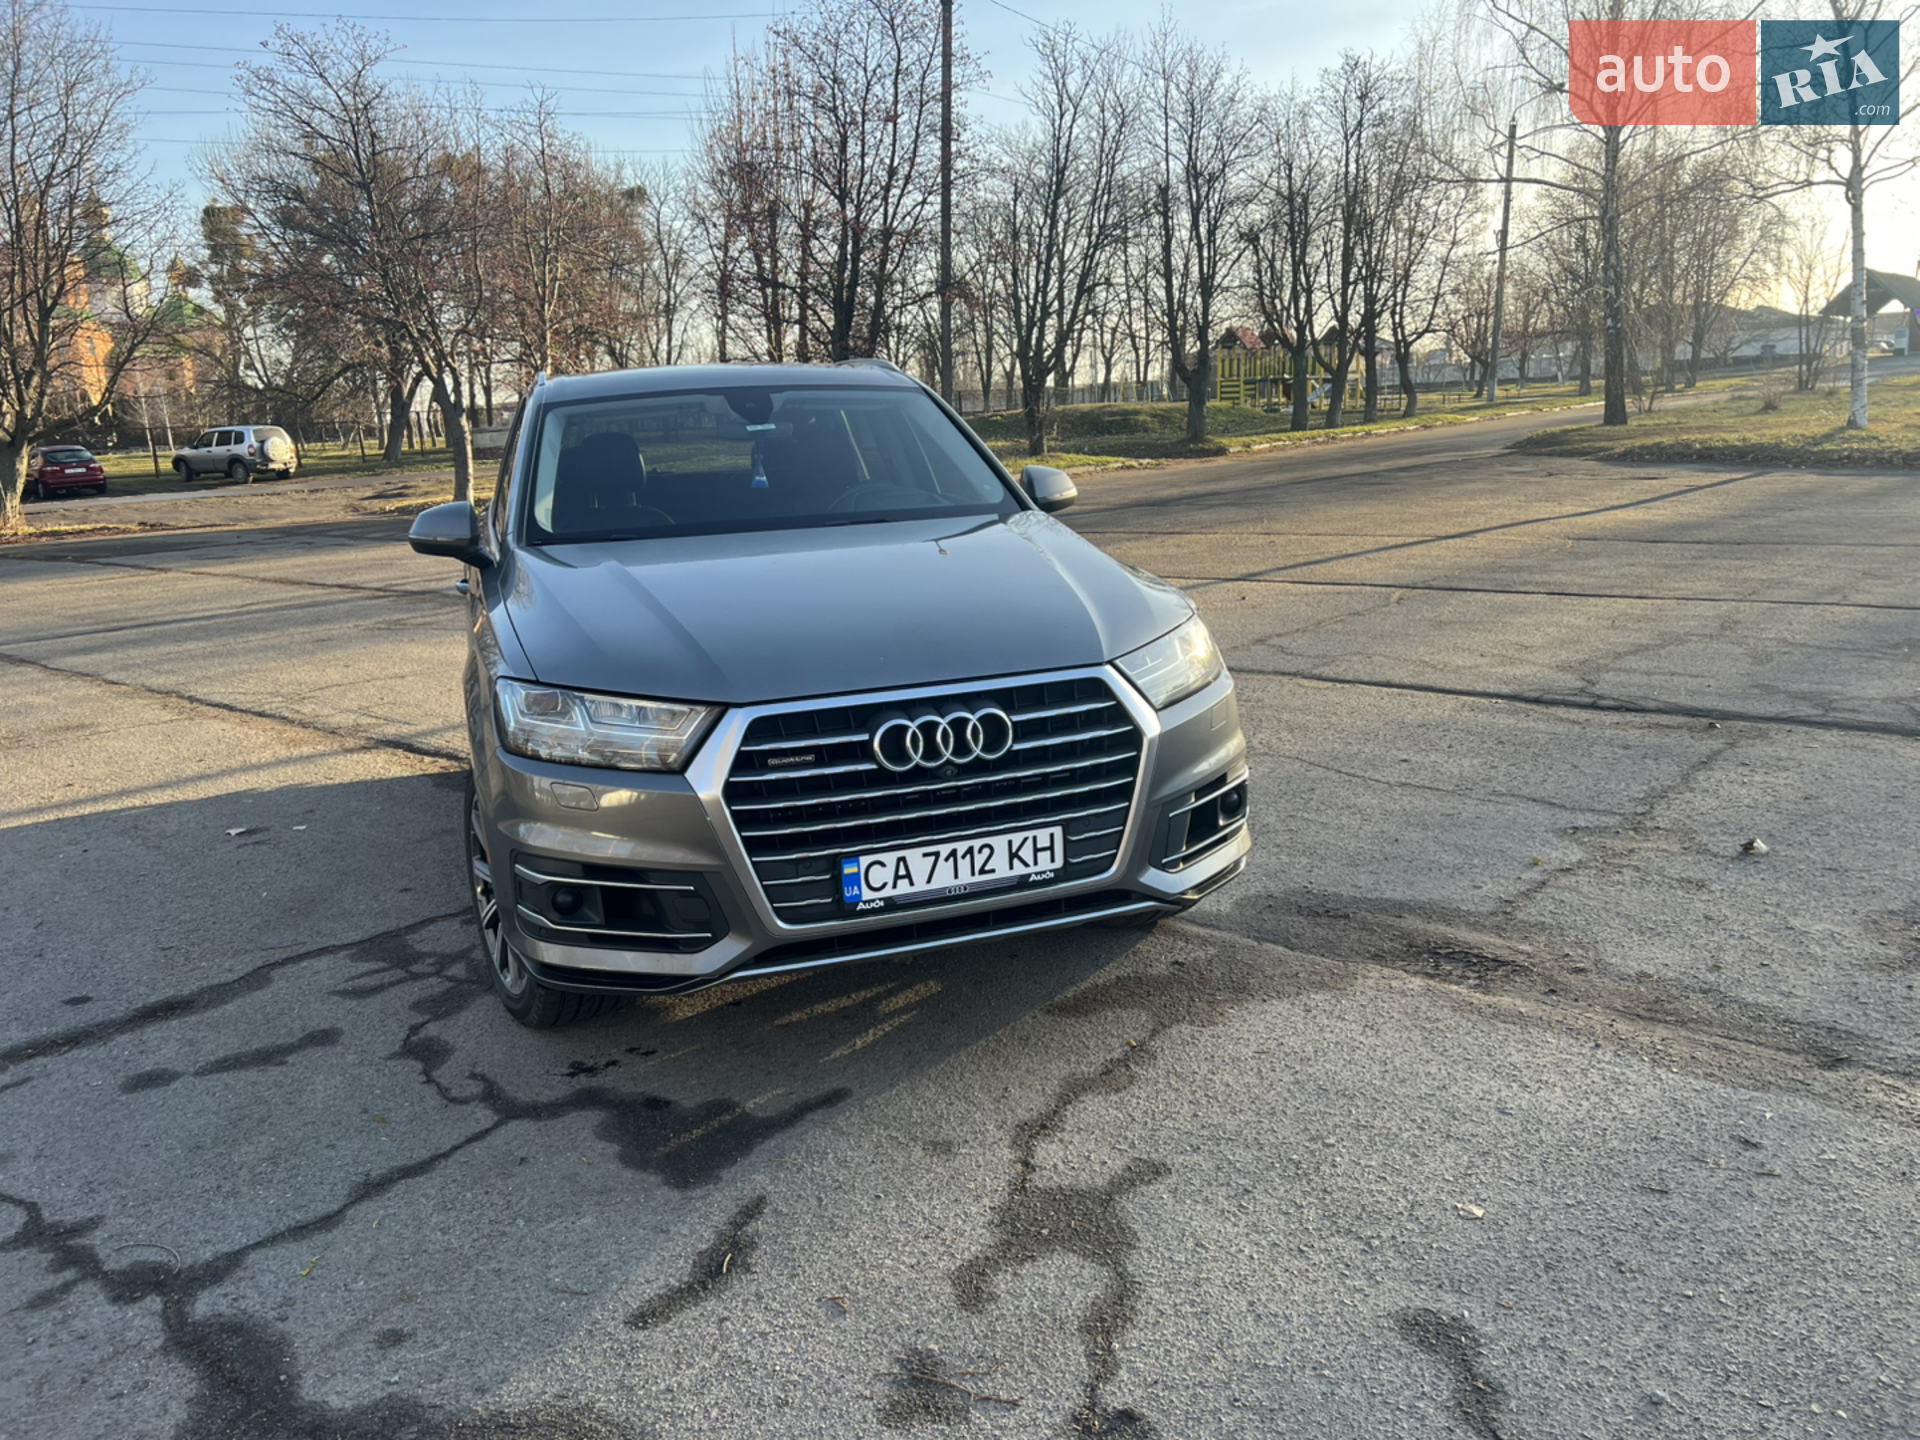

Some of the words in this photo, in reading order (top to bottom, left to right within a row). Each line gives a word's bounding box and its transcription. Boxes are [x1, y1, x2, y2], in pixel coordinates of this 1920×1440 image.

[863, 856, 915, 892] CA
[922, 843, 996, 884] 7112
[1007, 832, 1056, 871] KH
[1029, 871, 1054, 882] Audi
[844, 885, 860, 896] UA
[856, 899, 884, 911] Audi
